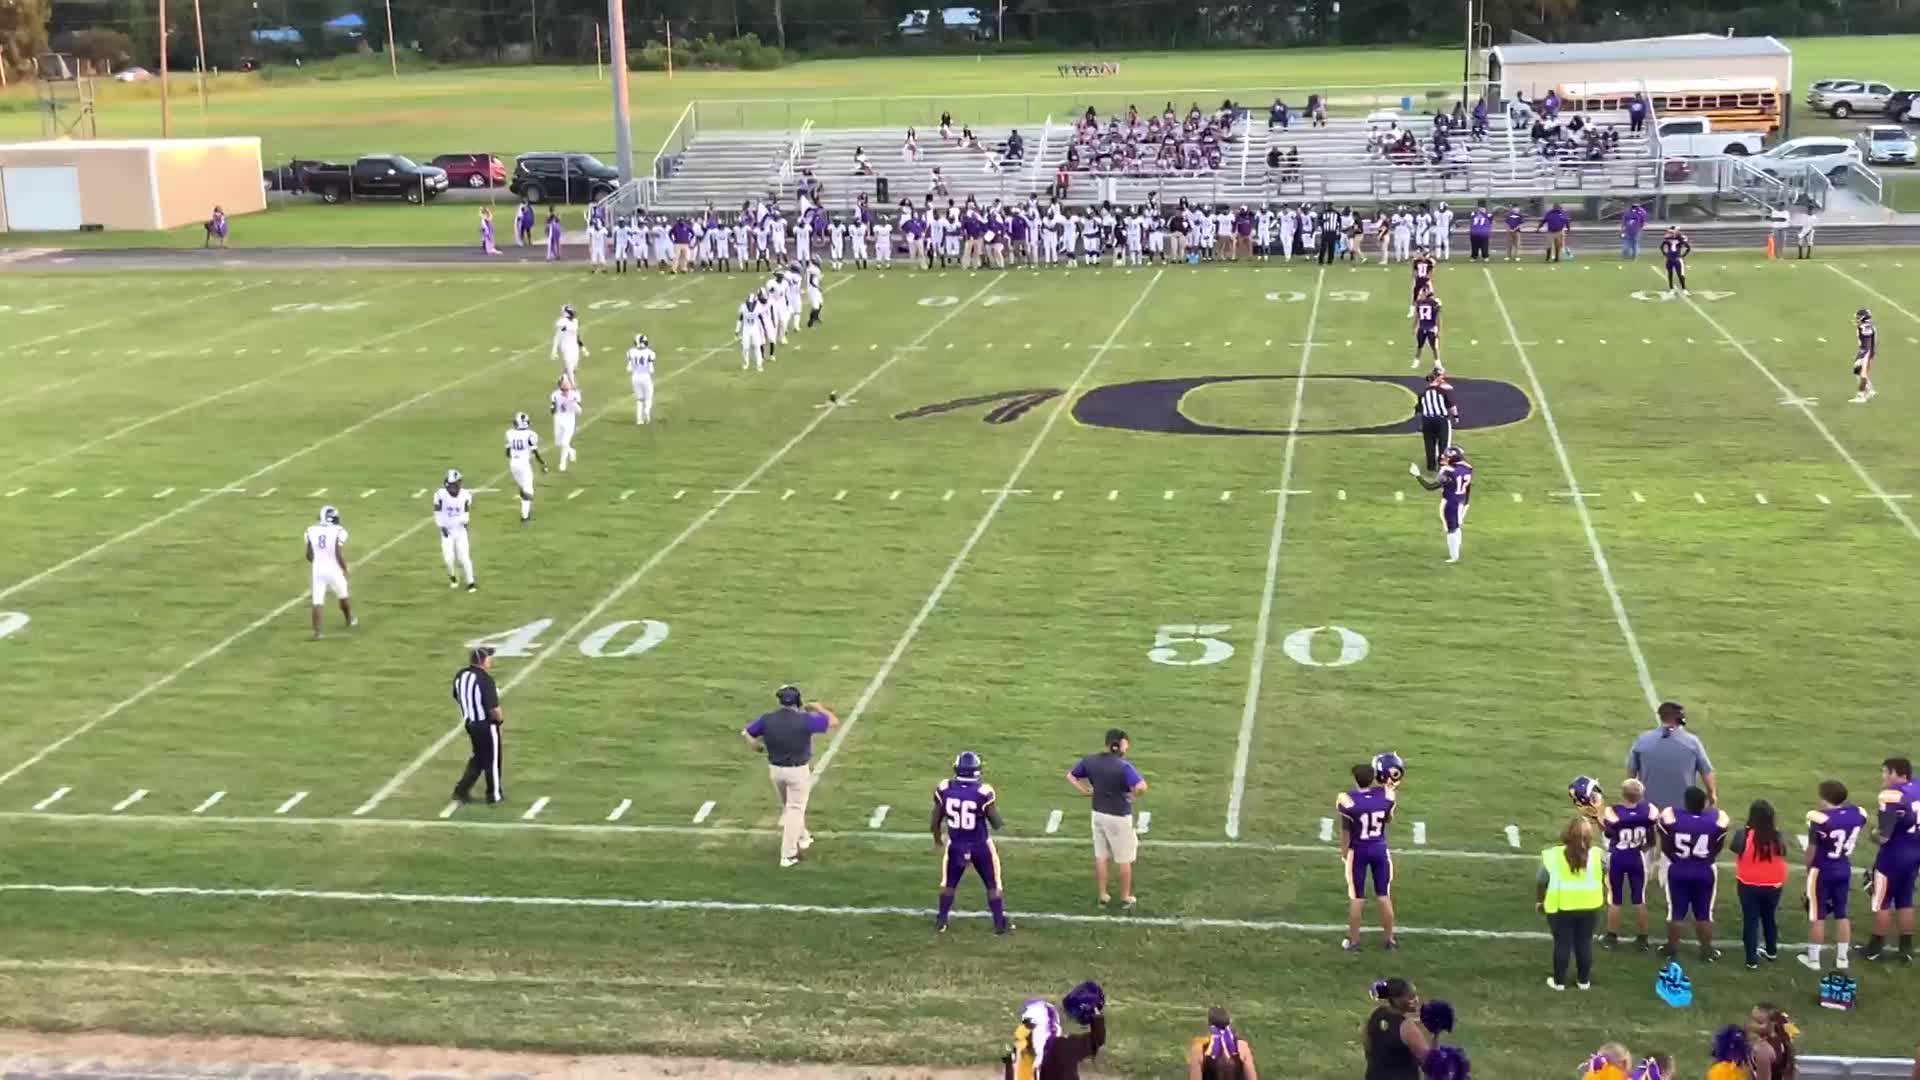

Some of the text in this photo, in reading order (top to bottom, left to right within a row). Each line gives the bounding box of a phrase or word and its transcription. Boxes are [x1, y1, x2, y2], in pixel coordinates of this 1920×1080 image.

[318, 534, 327, 549] 8
[945, 797, 977, 830] 56
[1359, 811, 1386, 840] 15
[1674, 833, 1710, 858] 54
[1826, 826, 1861, 859] 34
